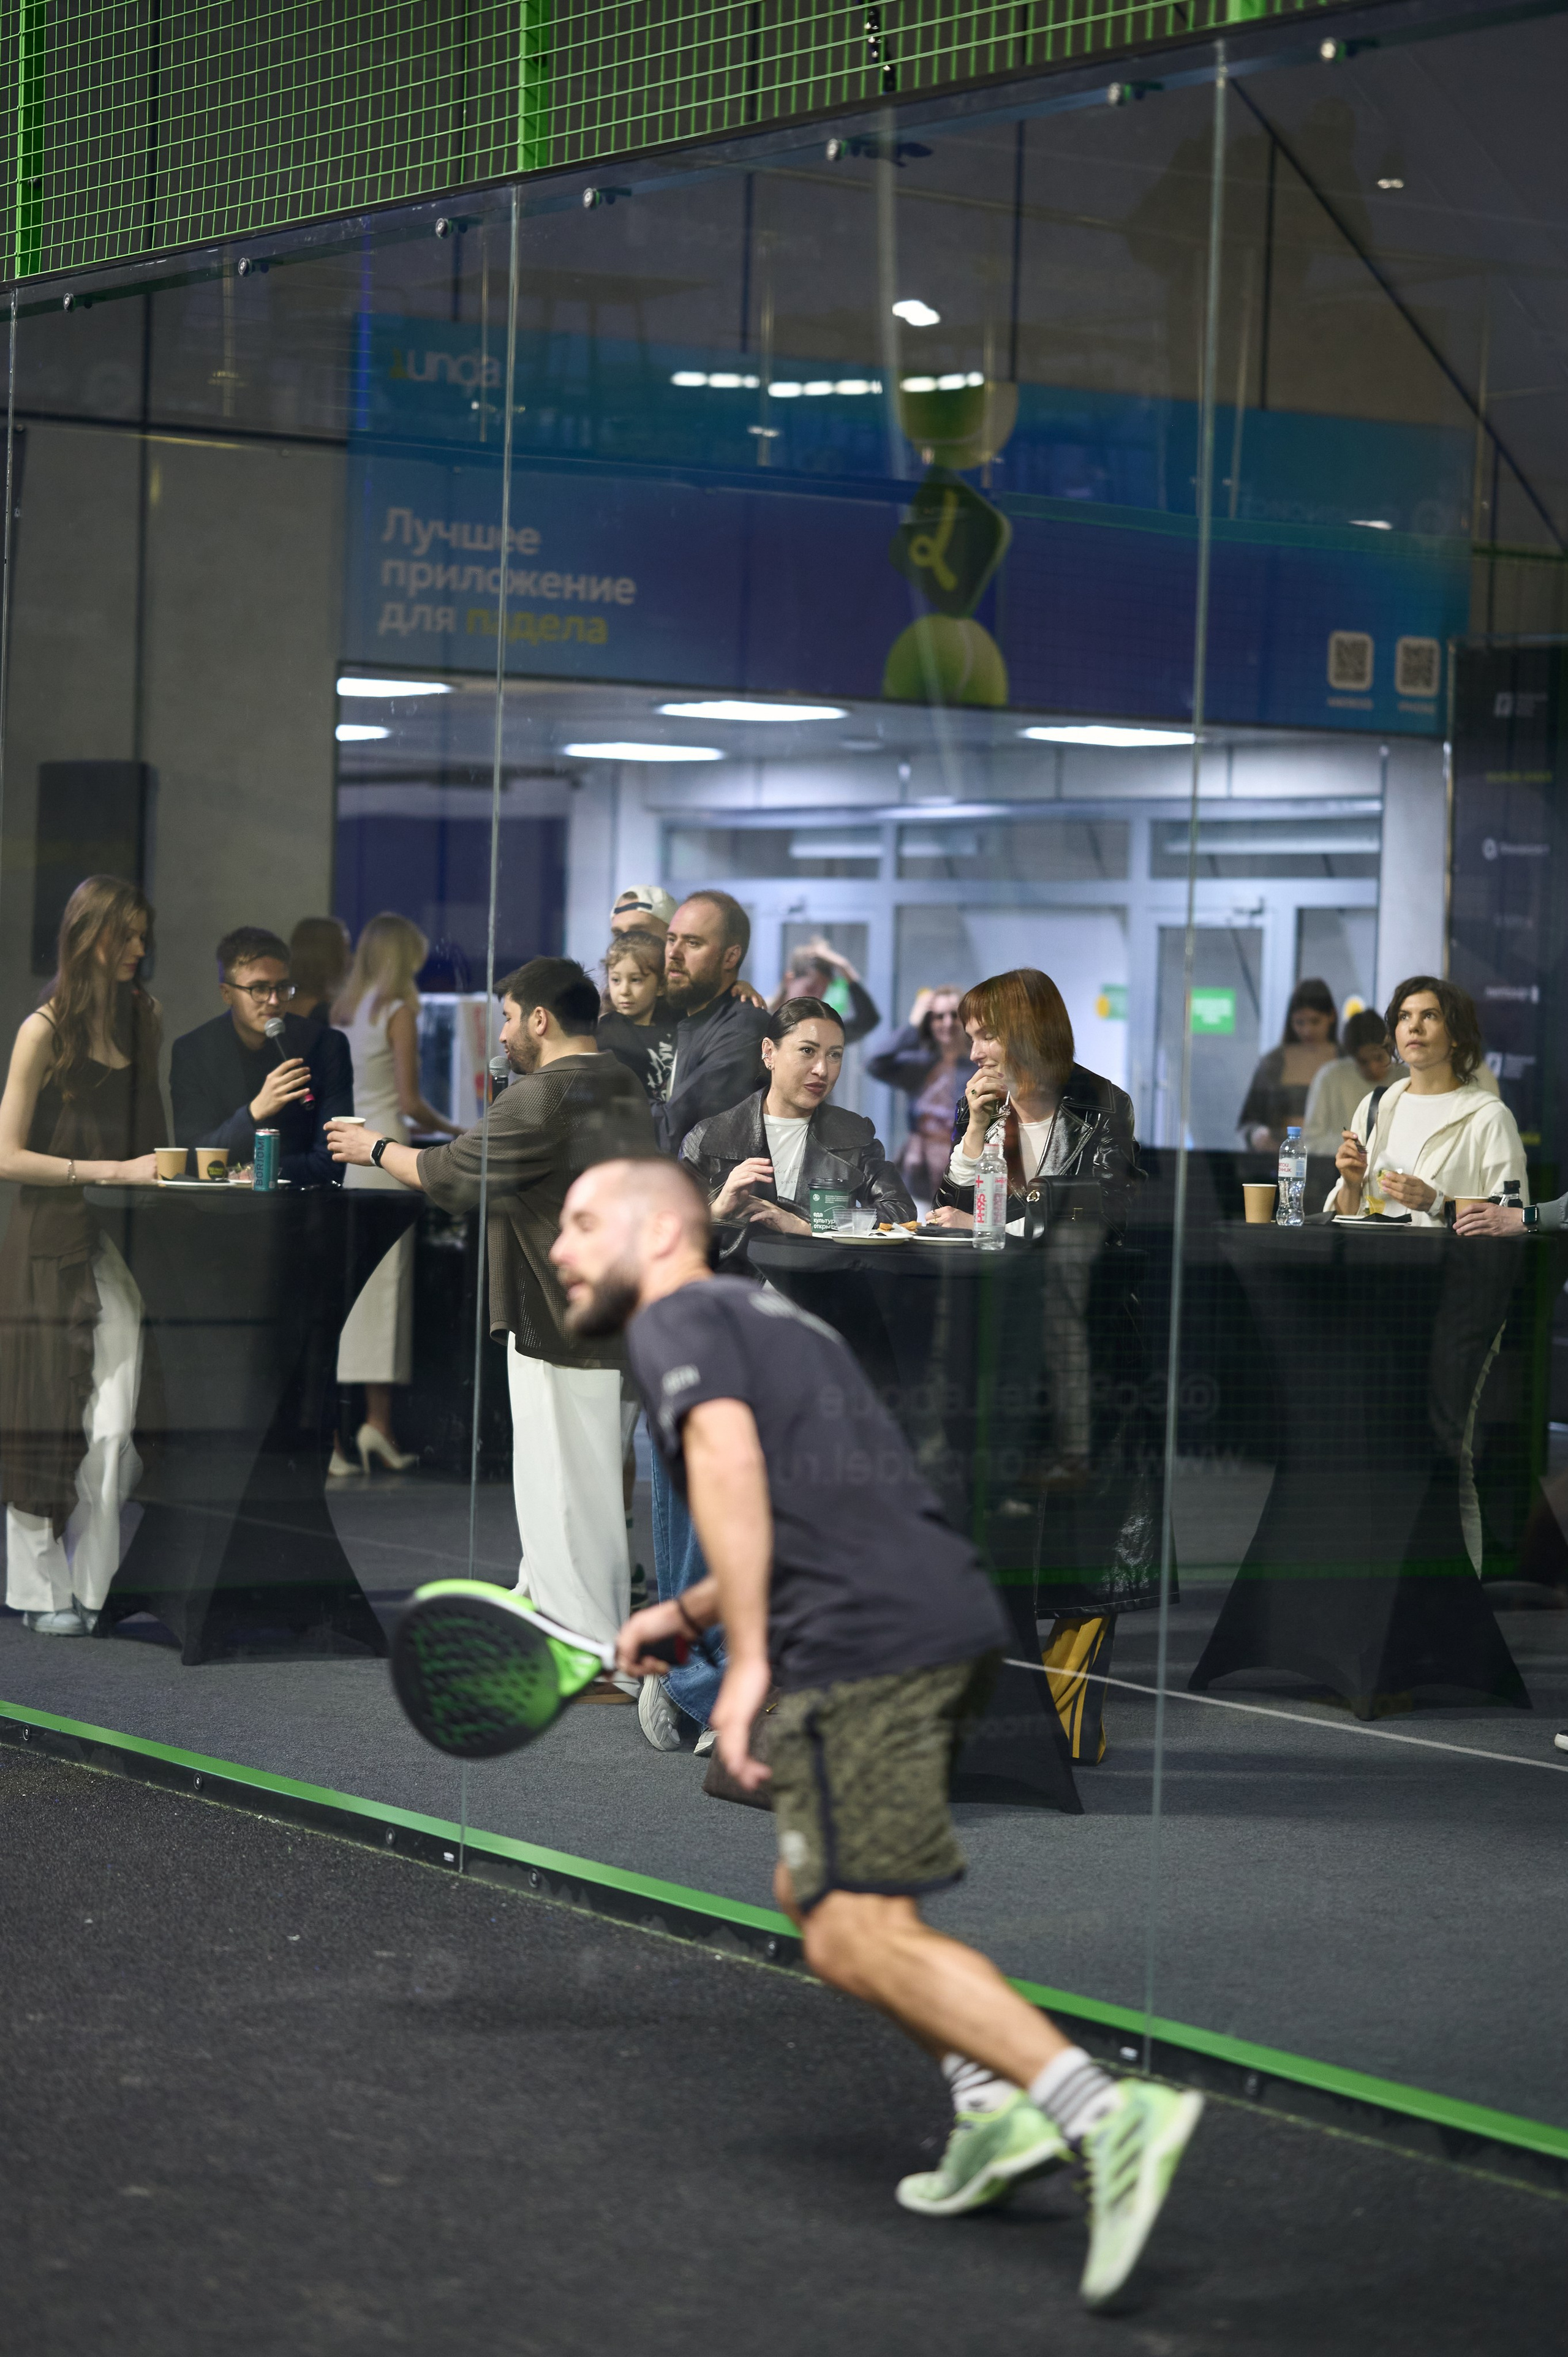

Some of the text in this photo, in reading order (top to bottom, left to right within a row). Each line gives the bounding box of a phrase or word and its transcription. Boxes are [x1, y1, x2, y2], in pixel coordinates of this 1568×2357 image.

[382, 508, 540, 554] Лучшее
[382, 560, 636, 604] приложение
[379, 603, 454, 636] для
[256, 1138, 265, 1186] BORJOMI
